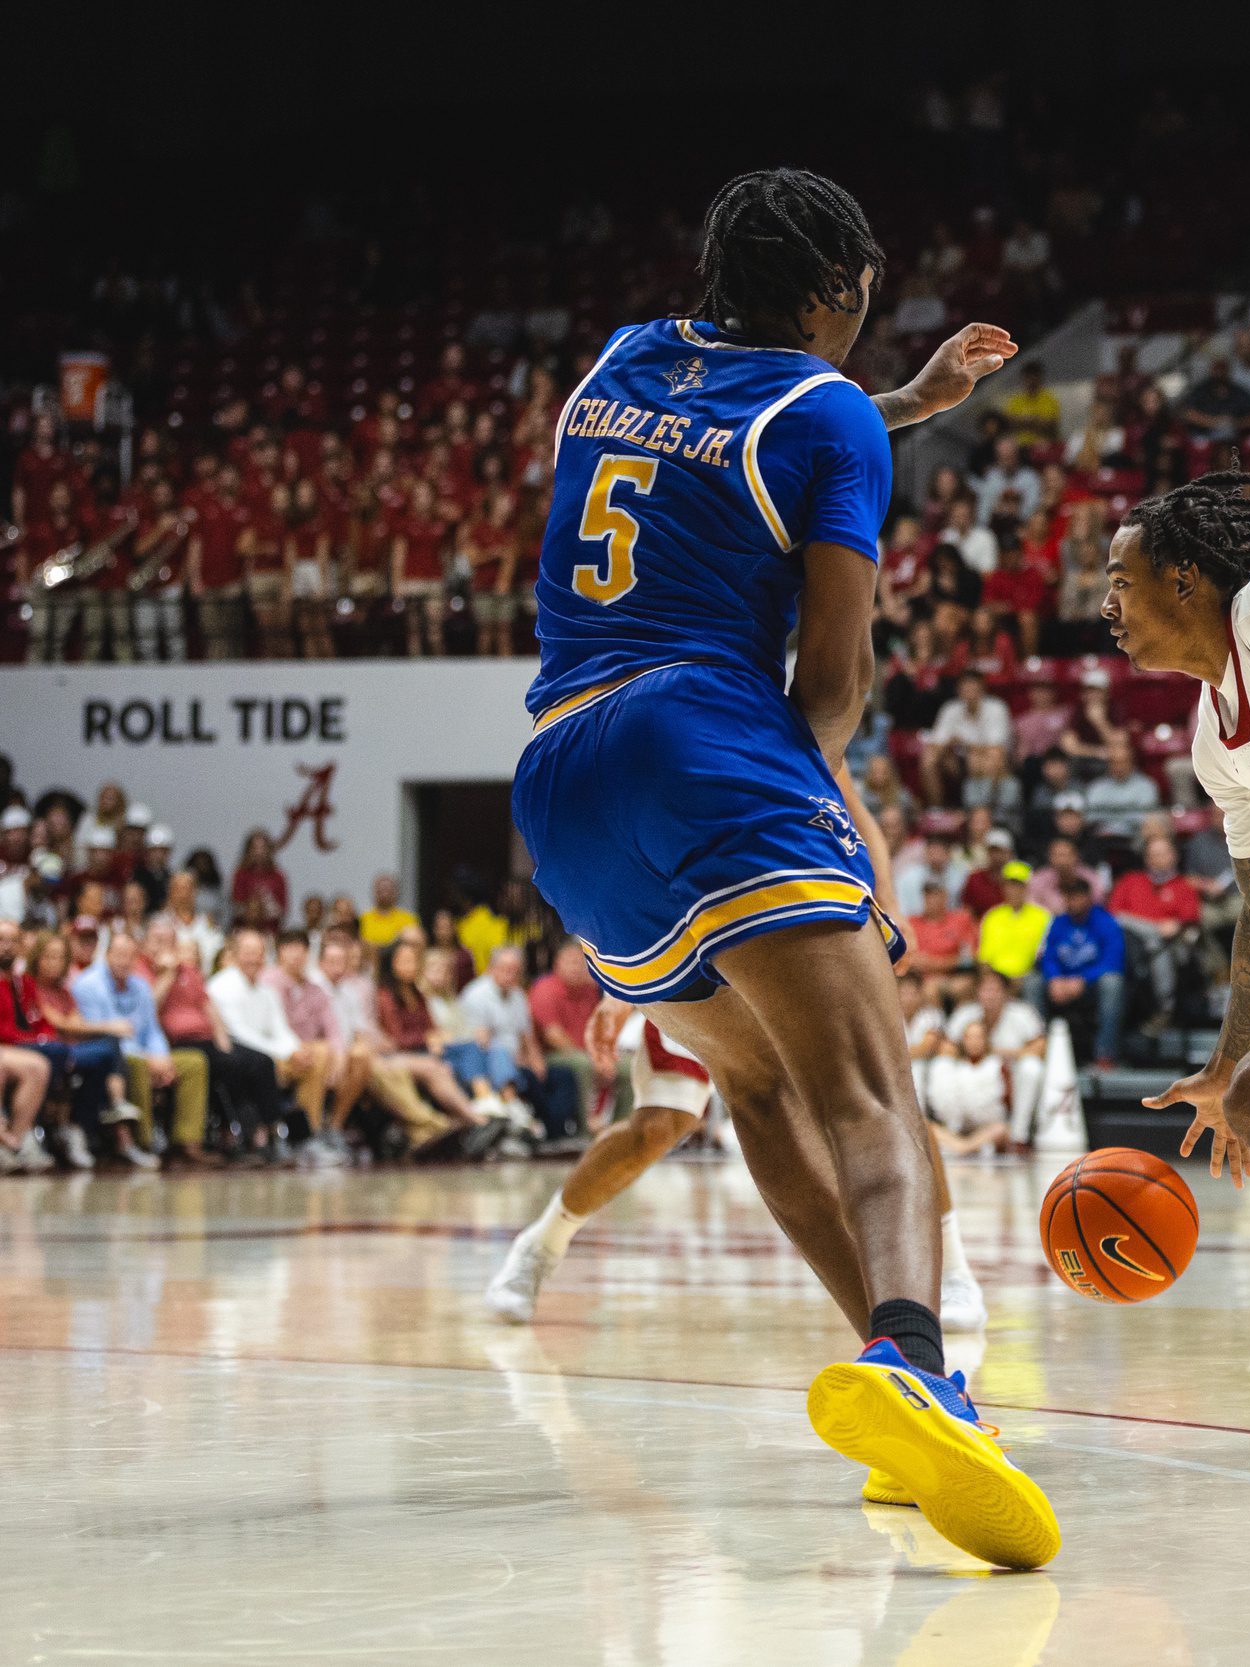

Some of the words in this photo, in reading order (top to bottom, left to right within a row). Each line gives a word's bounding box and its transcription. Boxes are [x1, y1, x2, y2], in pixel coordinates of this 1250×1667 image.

[566, 397, 692, 454] CHARLES
[683, 427, 734, 468] JR.
[571, 453, 660, 607] 5
[83, 696, 216, 744] ROLL
[231, 696, 346, 744] TIDE
[1056, 1249, 1110, 1301] ELIT
